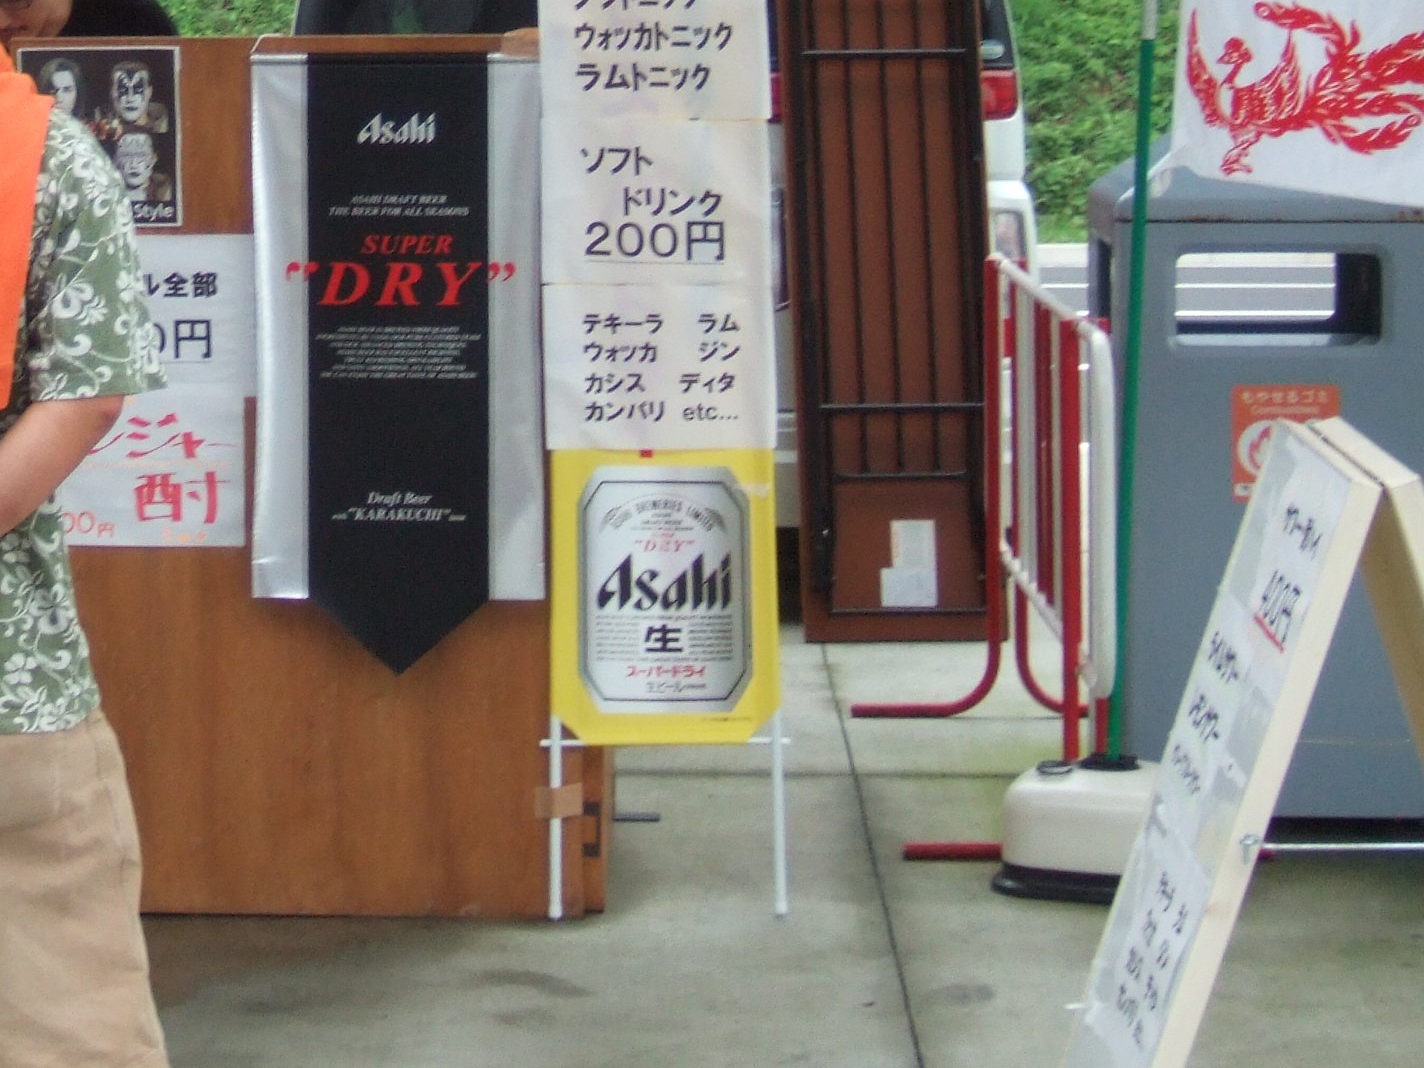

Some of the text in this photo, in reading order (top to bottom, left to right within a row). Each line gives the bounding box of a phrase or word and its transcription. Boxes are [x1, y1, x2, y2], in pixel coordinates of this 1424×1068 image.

[574, 21, 734, 52] ウォッカトニック
[575, 62, 712, 92] ラムトニック
[357, 111, 436, 145] Asahi
[579, 145, 654, 177] ソフト
[623, 186, 723, 218] ドリンク
[360, 234, 456, 255] SUPER
[583, 220, 726, 262] 200円
[582, 312, 742, 334] テキーラ ラム
[582, 340, 741, 364] ウォッカ ジン
[584, 372, 646, 395] カシス
[596, 552, 732, 611] Asahi
[643, 623, 684, 654] 生
